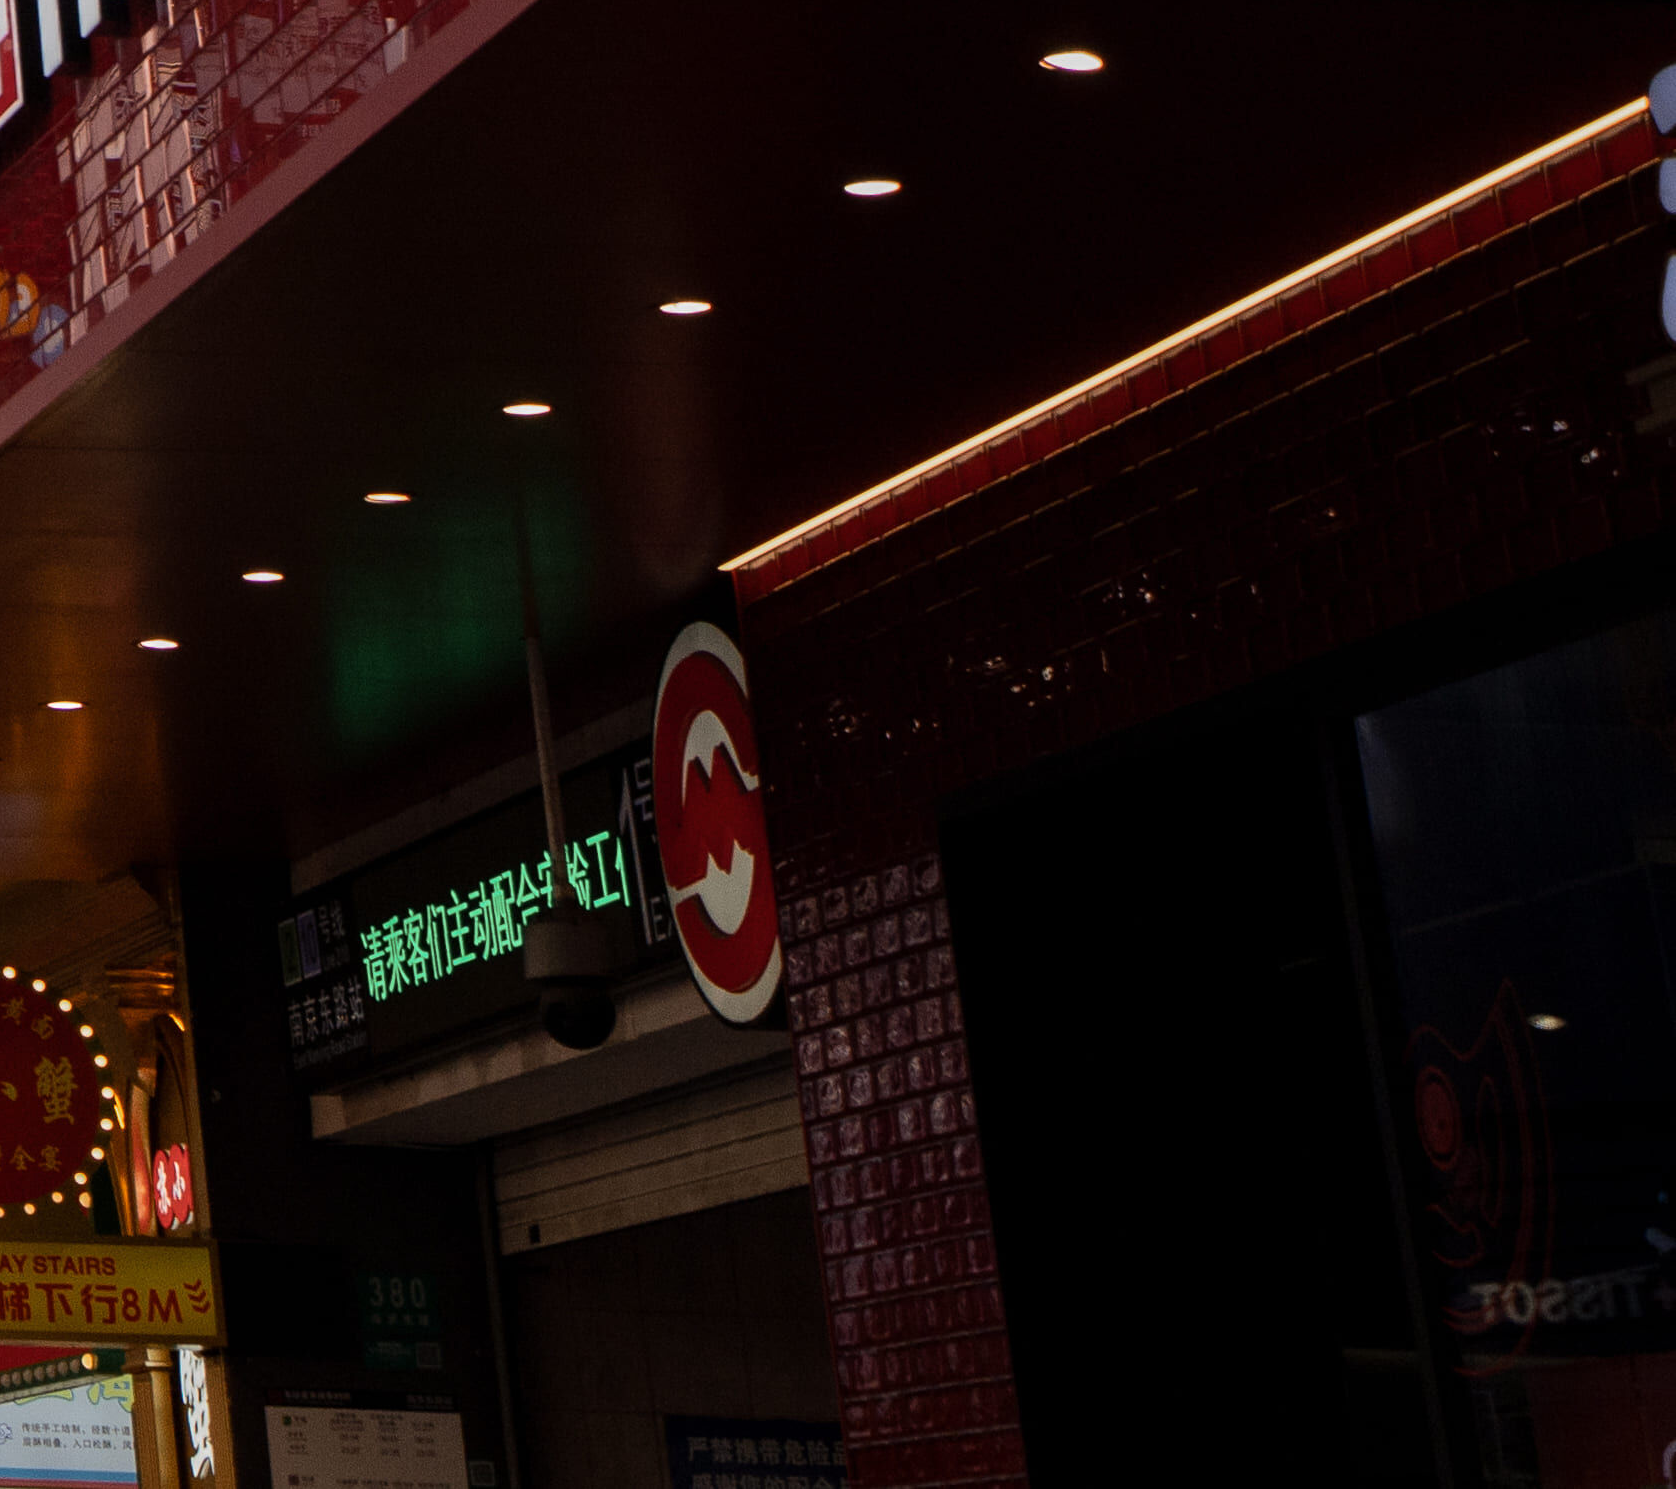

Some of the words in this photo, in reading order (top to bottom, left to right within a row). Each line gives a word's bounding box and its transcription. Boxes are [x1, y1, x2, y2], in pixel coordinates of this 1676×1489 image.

[359, 828, 633, 1006] 请乘客们主动配合检工
[32, 1255, 117, 1276] STAIRS
